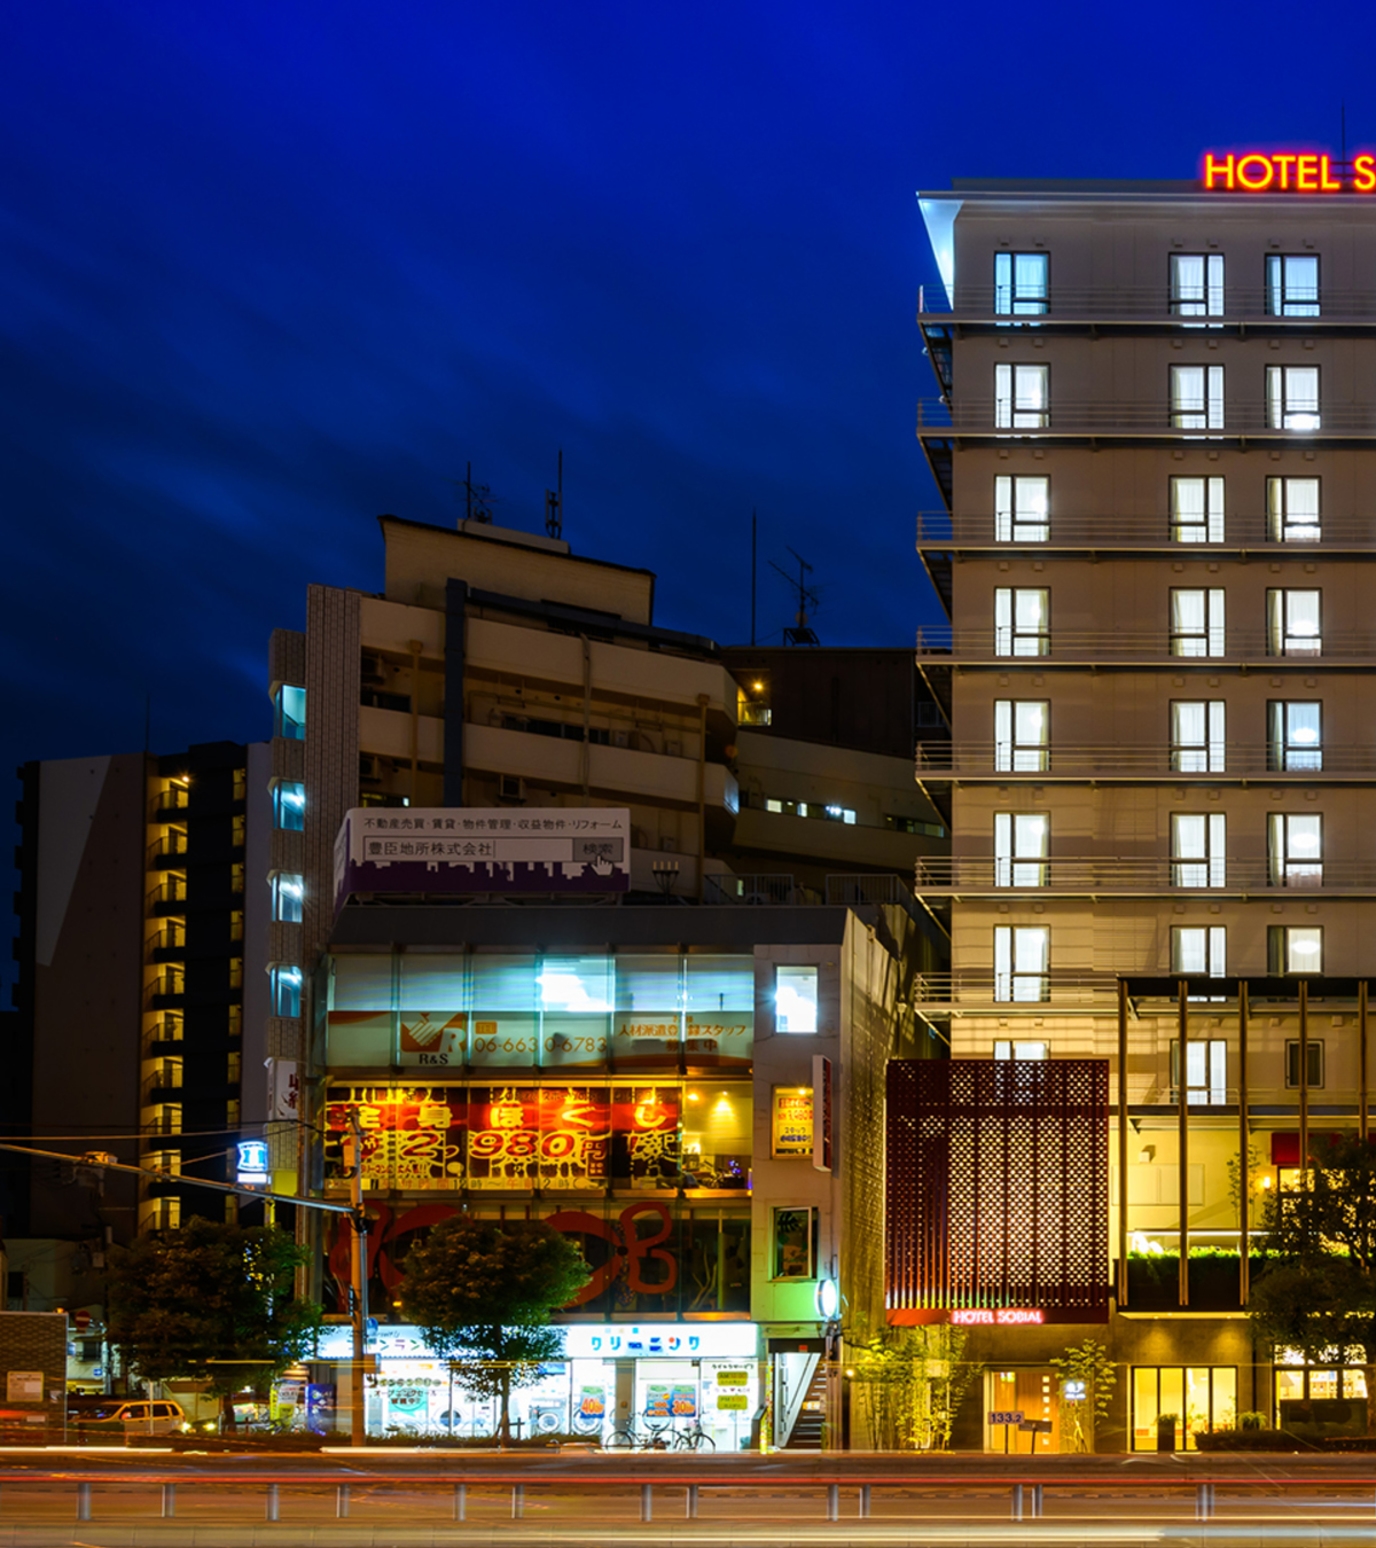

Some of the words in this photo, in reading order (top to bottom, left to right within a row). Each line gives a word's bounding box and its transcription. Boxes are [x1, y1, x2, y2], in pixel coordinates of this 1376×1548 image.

[1205, 153, 1341, 189] HOTEL
[368, 841, 493, 857] 豊臣地所株式会社
[582, 842, 614, 855] 検索
[418, 1053, 449, 1065] R&S
[952, 1310, 994, 1324] HOTEL
[997, 1310, 1043, 1324] SOBIAL
[990, 1412, 1022, 1424] 133.2
